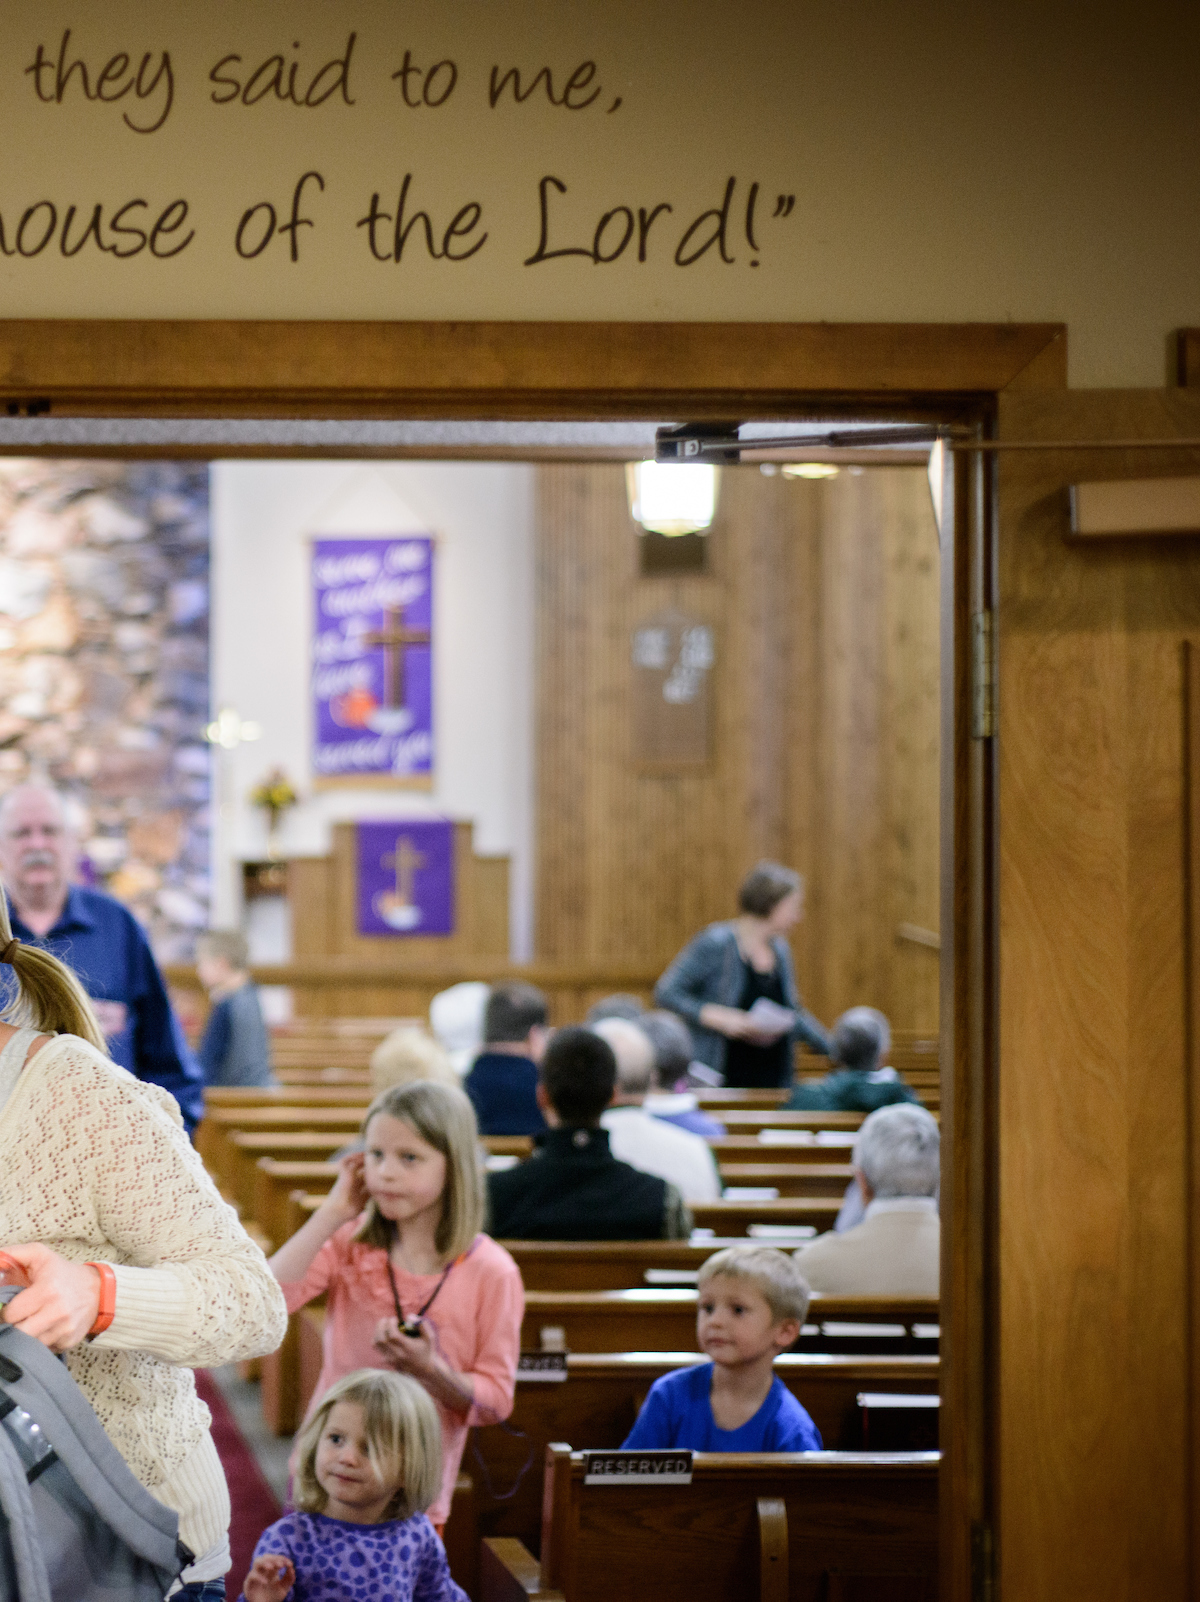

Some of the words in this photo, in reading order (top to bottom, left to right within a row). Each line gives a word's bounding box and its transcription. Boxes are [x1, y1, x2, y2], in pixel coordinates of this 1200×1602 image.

[23, 27, 176, 135] they
[207, 30, 358, 109] said
[390, 48, 460, 109] to
[487, 58, 624, 115] me,
[233, 169, 327, 264] of
[355, 171, 489, 265] the
[590, 1458, 688, 1475] RESERVED
